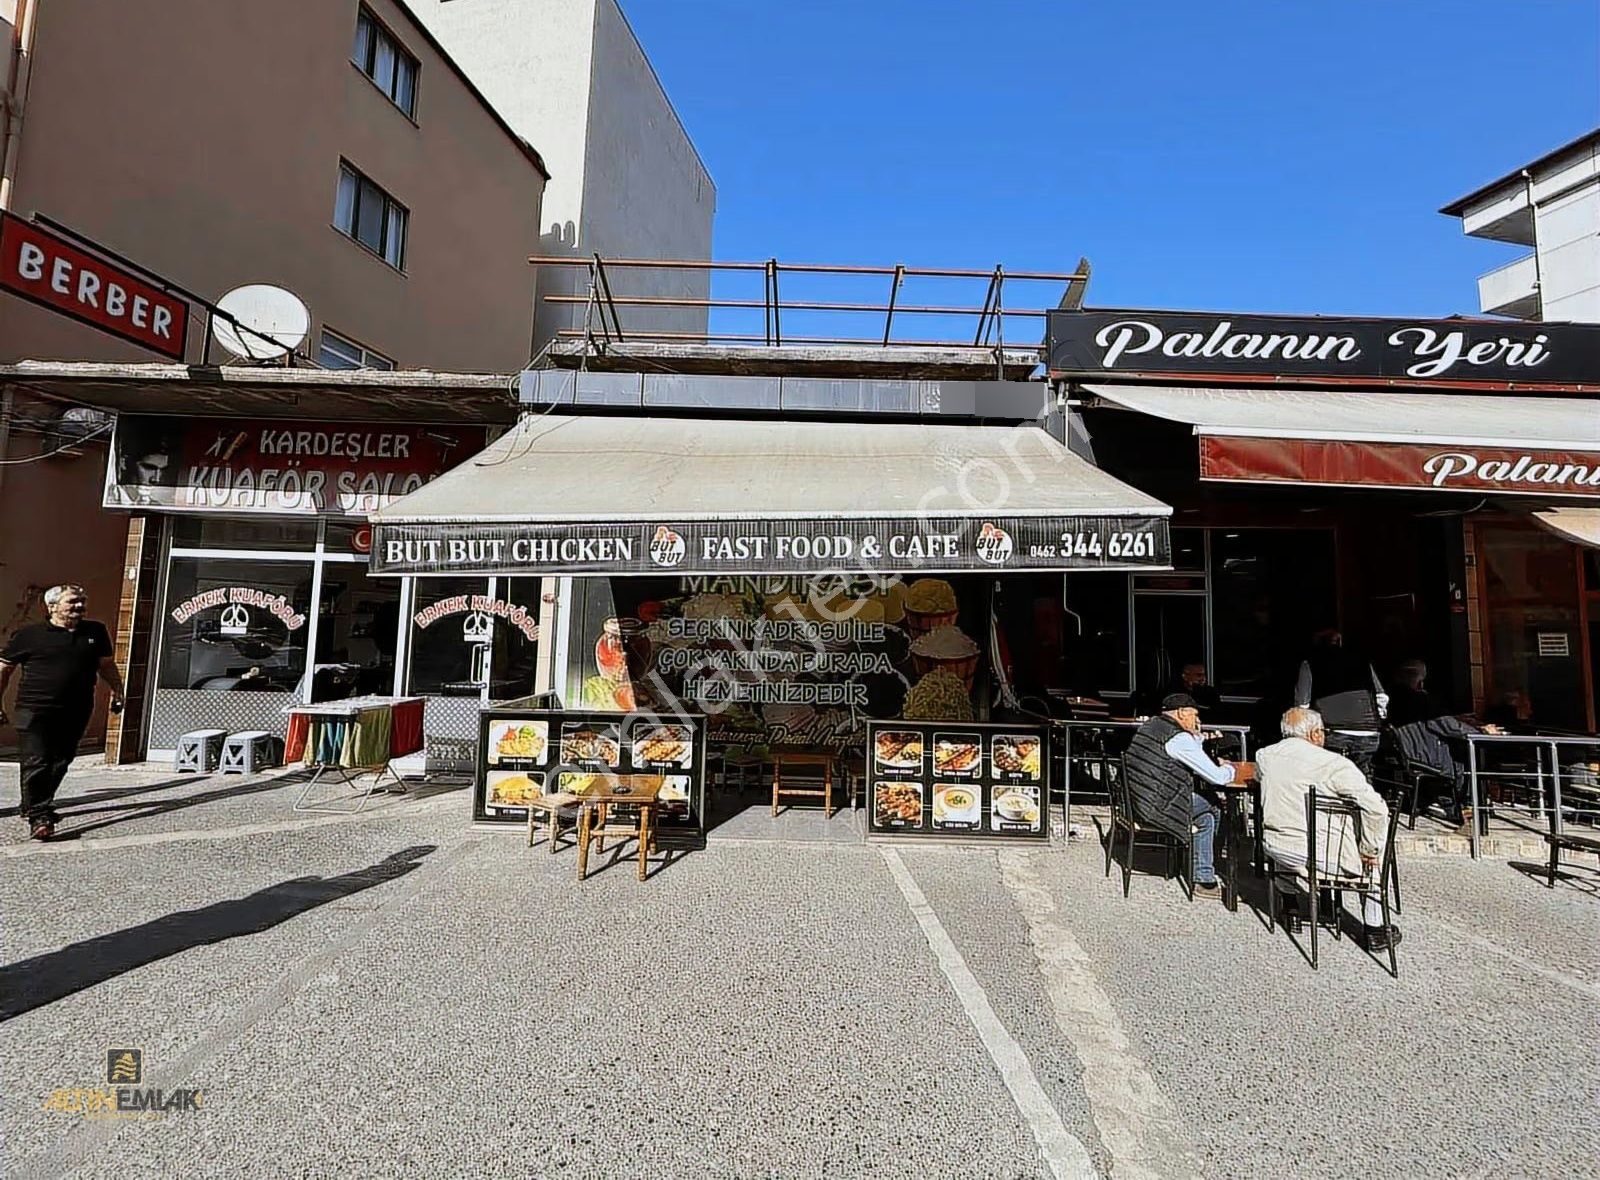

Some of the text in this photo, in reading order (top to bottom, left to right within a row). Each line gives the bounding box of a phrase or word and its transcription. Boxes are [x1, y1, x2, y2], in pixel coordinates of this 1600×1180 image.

[18, 241, 173, 340] BERBER
[1095, 321, 1553, 379] Palanın Yeri
[259, 429, 410, 462] KARDEŞLER
[335, 470, 437, 513] SALO
[385, 537, 634, 563] BUT BUT CHICKEN
[651, 540, 677, 552] BUT
[701, 534, 960, 560] FAST FOOD & CAFE
[977, 537, 1004, 549] BUT
[985, 550, 1010, 560] BUT
[1060, 532, 1102, 557] 344
[1108, 532, 1155, 557] 6261
[659, 552, 682, 564] BUT
[171, 587, 227, 625] ERKEK
[413, 594, 469, 630] ERKEK
[658, 648, 704, 674] ÇOK
